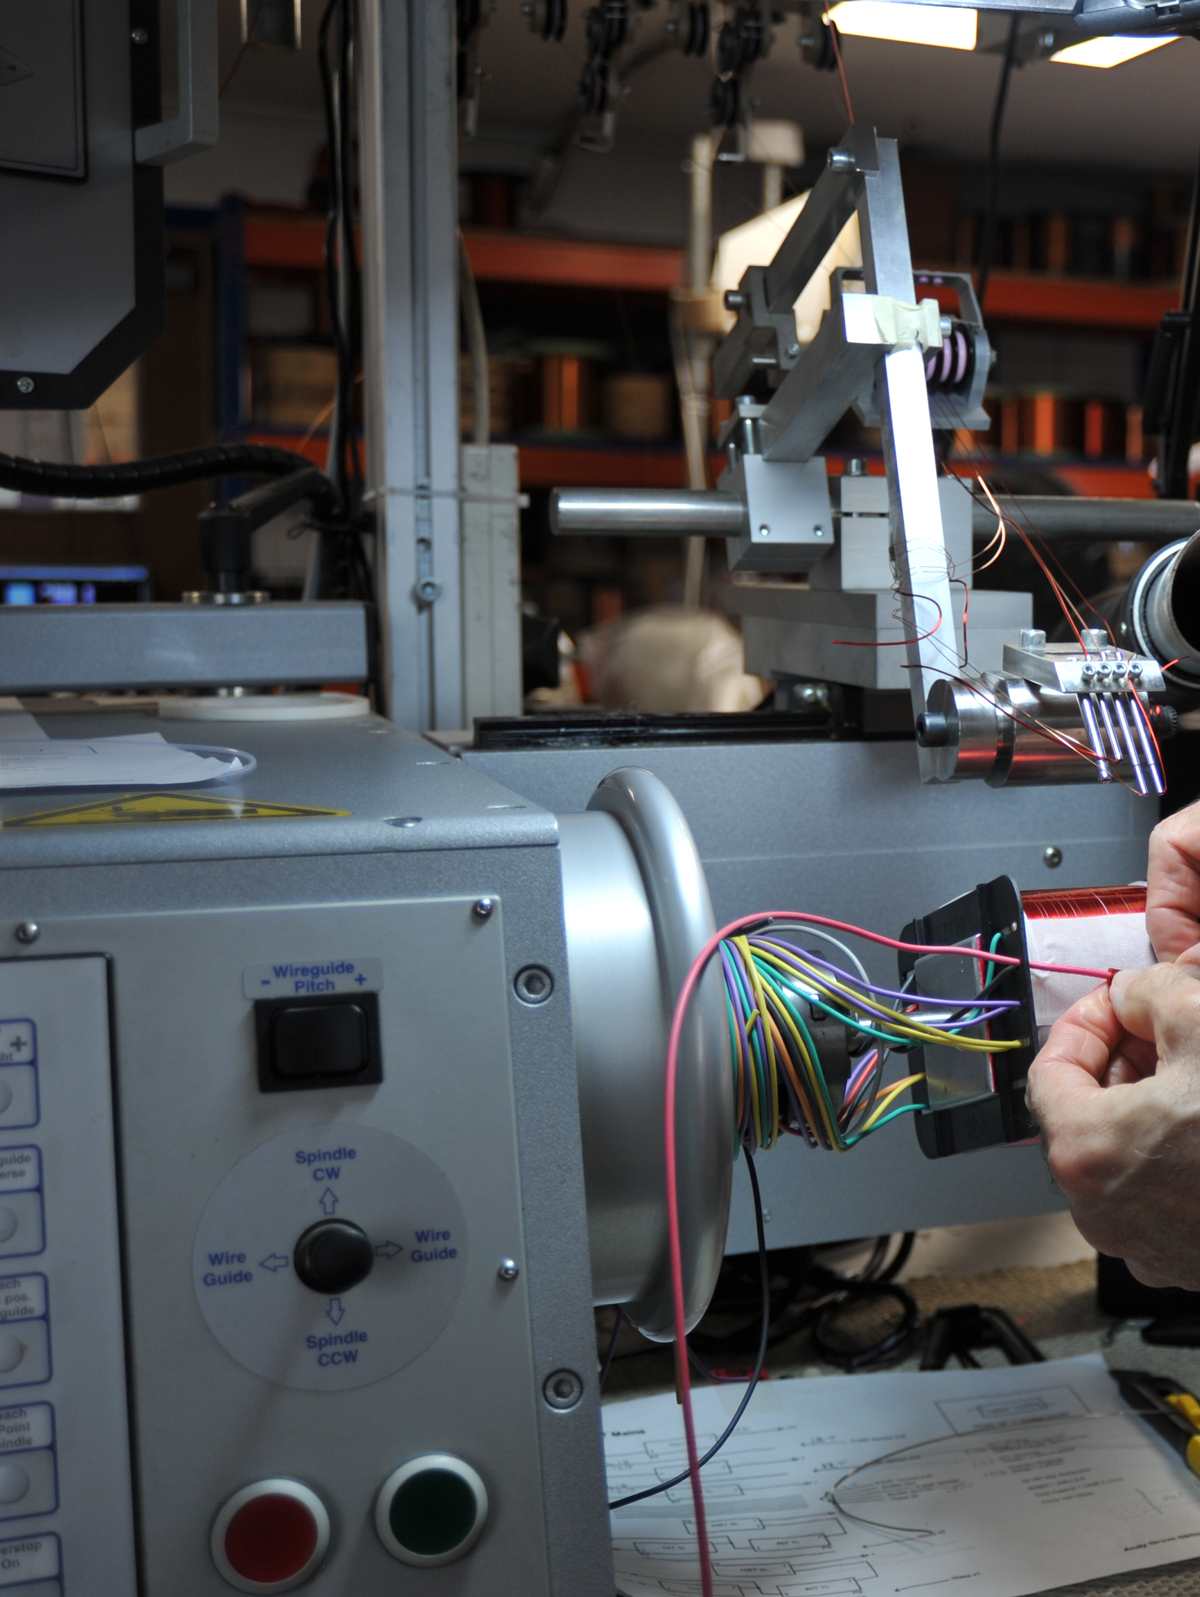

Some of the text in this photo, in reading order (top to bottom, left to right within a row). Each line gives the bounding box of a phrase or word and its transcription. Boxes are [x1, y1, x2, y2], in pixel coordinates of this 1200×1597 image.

[273, 961, 355, 980] Wireguide
[294, 978, 336, 993] Pitch
[295, 1147, 357, 1166] Spindle
[312, 1166, 341, 1182] CW
[415, 1229, 451, 1244] Wire
[208, 1251, 247, 1267] Wire
[411, 1247, 458, 1264] Guide
[203, 1269, 253, 1287] Guide
[0, 1305, 35, 1320] guide
[306, 1330, 368, 1349] Spindle
[318, 1349, 359, 1367] CCW
[1, 1558, 20, 1569] On
